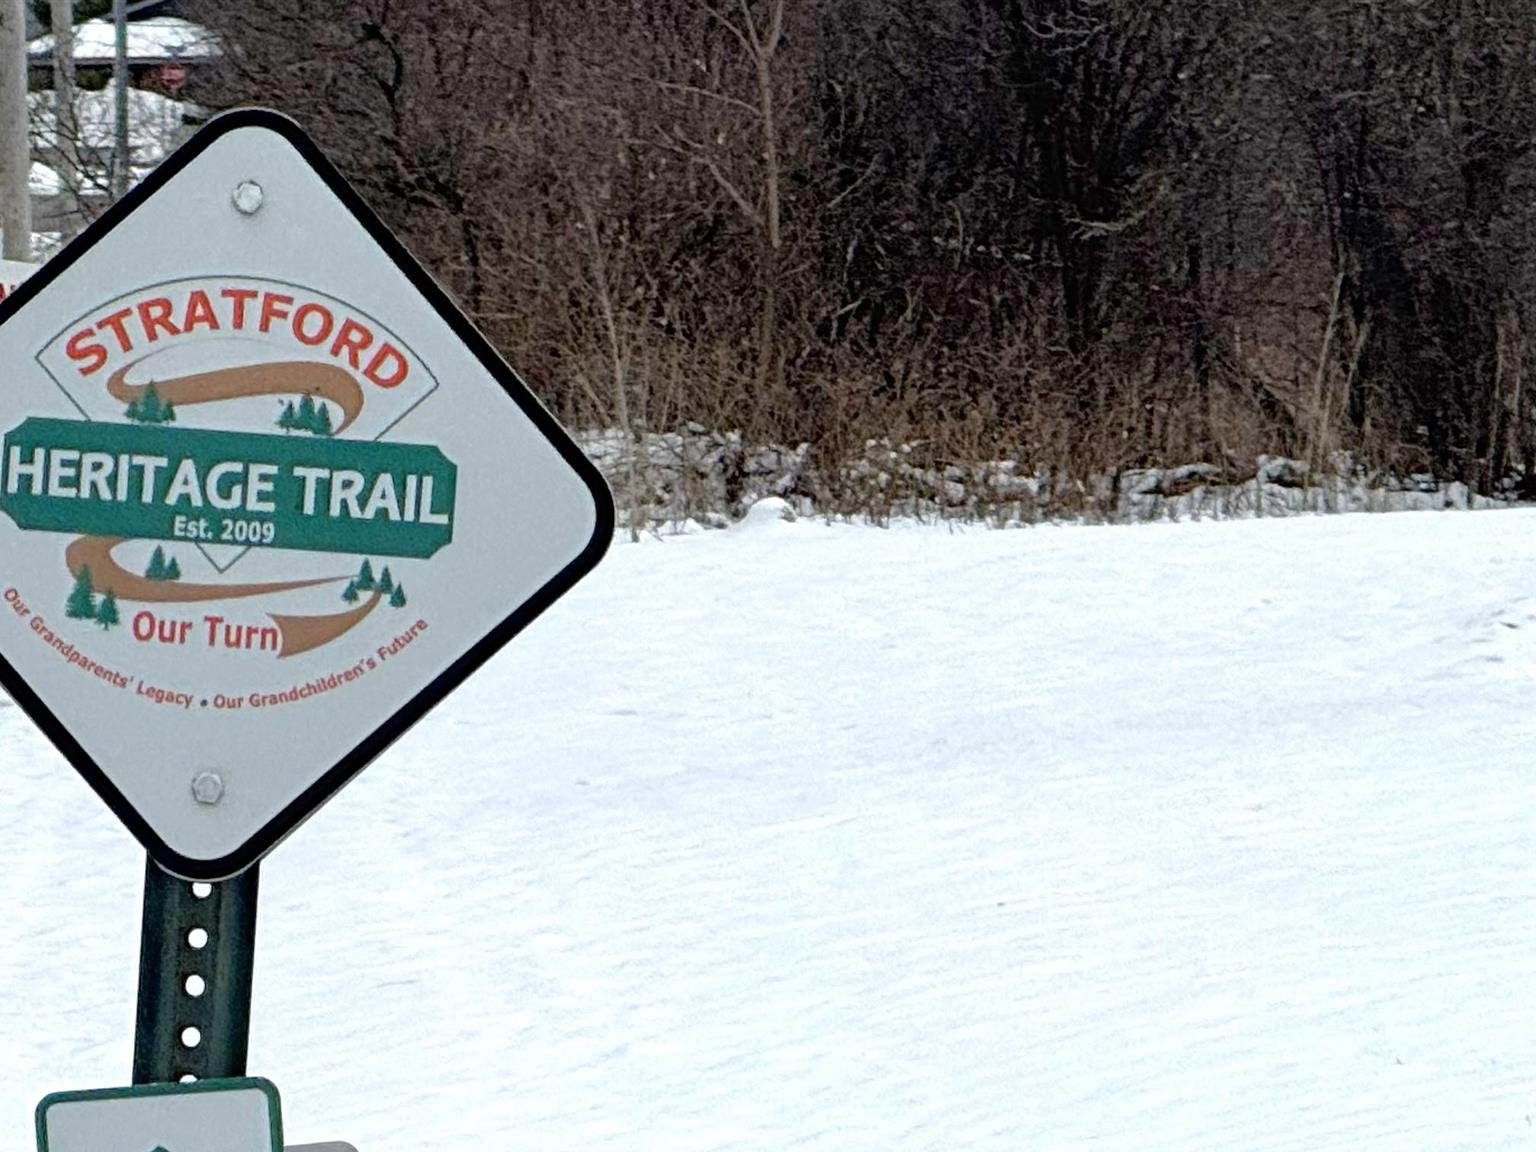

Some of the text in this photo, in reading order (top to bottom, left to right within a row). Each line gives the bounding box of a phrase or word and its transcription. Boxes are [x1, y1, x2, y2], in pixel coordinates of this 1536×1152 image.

[65, 288, 410, 390] STRATFORD
[6, 444, 450, 526] HERITAGE TRAIL
[173, 515, 276, 544] Est. 2009
[4, 587, 429, 710] Our Grandparents' Legacy Our Grandchildren's Future
[132, 610, 279, 651] Our Turn
